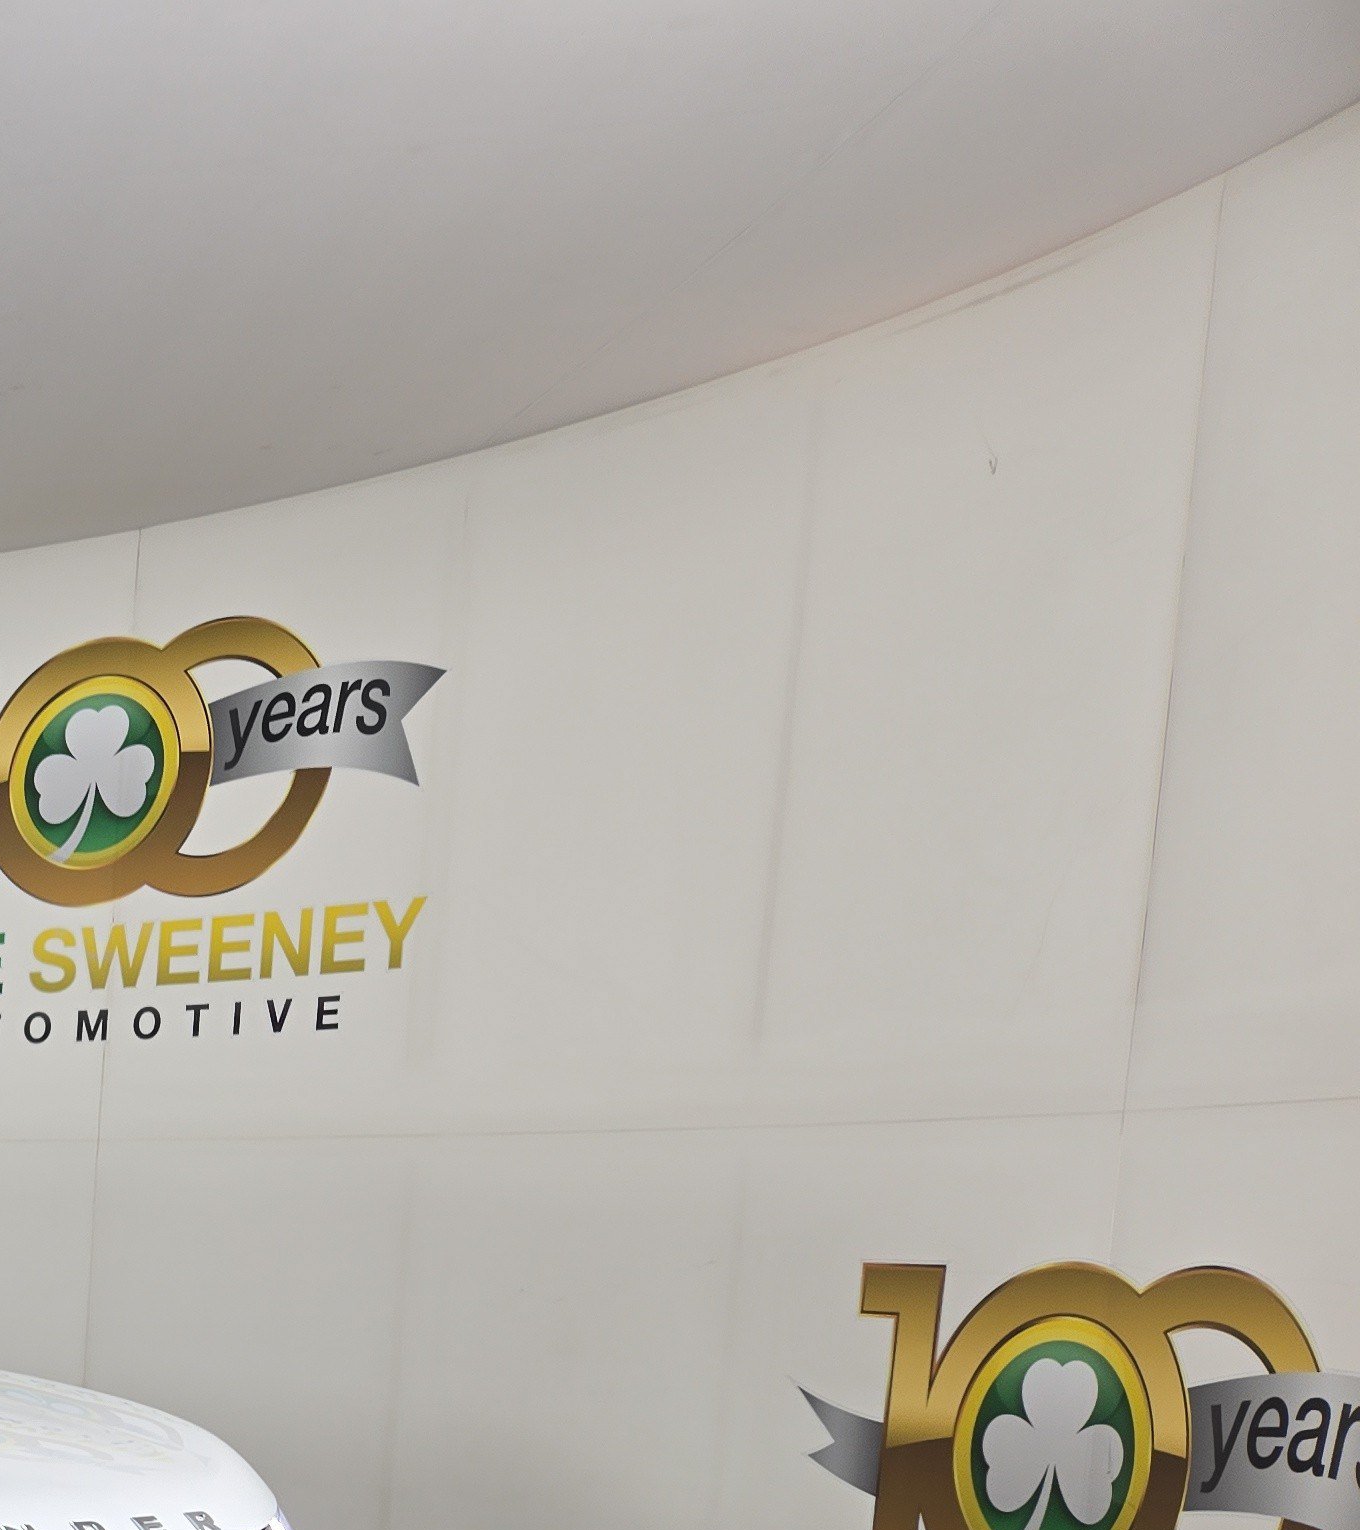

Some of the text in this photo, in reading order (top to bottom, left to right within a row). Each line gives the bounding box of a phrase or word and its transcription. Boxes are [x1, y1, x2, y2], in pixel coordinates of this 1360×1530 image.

[223, 675, 392, 771] years
[28, 896, 428, 994] SWEENEY
[1200, 1396, 1360, 1493] year
